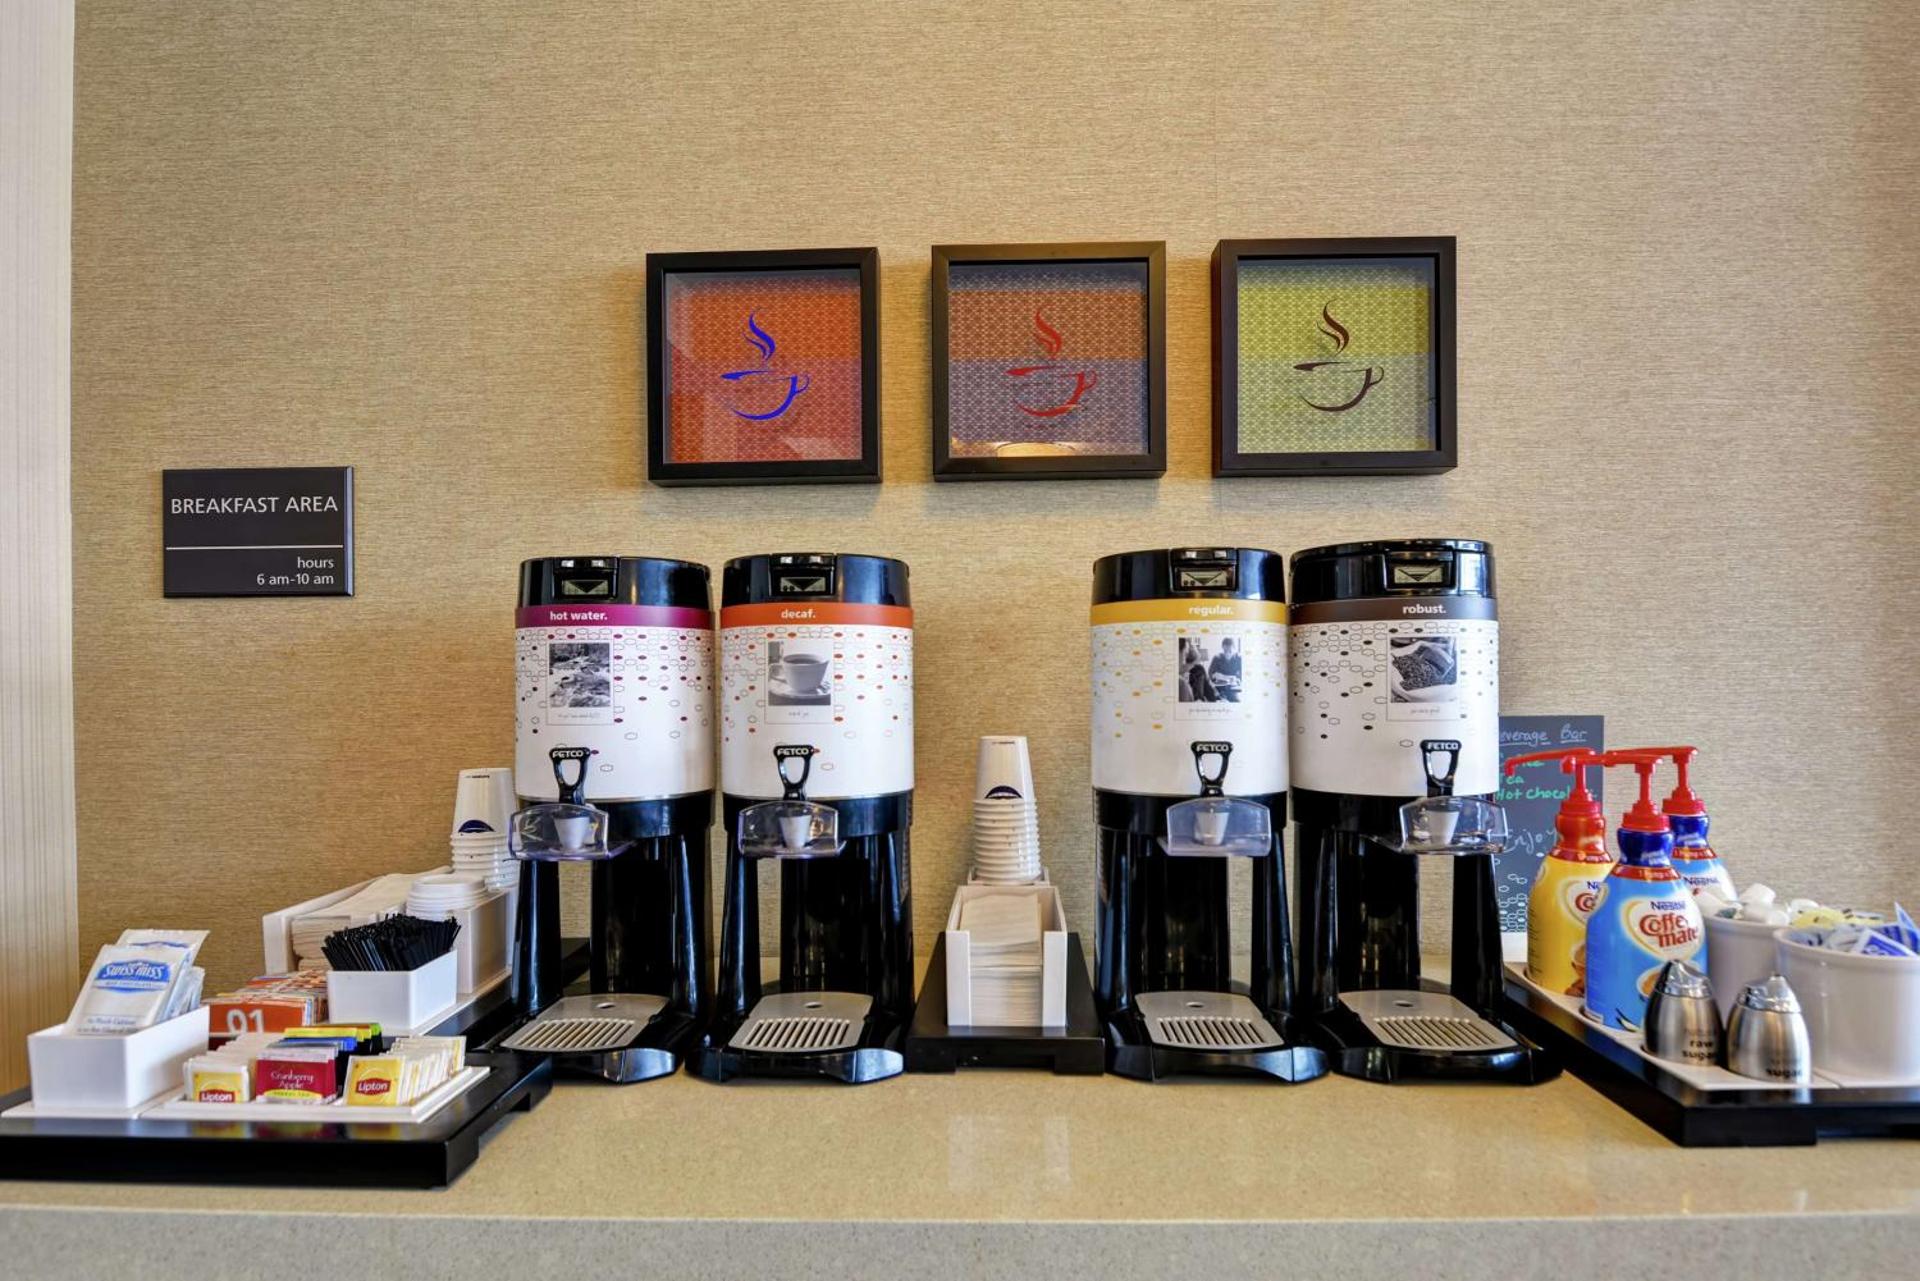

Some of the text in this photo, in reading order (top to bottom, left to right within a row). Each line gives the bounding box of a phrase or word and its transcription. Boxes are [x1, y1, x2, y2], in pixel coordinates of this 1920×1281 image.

[171, 496, 339, 514] BREAKFAST AREA
[297, 556, 334, 569] hours
[256, 573, 334, 585] 6 am-10 am
[781, 609, 816, 618] decaf.
[1189, 605, 1234, 616] regular.
[1402, 604, 1447, 614] robust.
[550, 611, 608, 620] hot water.
[1499, 730, 1549, 747] everage
[1196, 744, 1229, 752] FETCO
[1427, 742, 1459, 750] FETCO
[552, 750, 584, 758] FETCO
[777, 748, 809, 756] FETCO
[1690, 1040, 1713, 1048] raw
[358, 1079, 388, 1093] Lipton
[201, 1091, 233, 1102] Lipton
